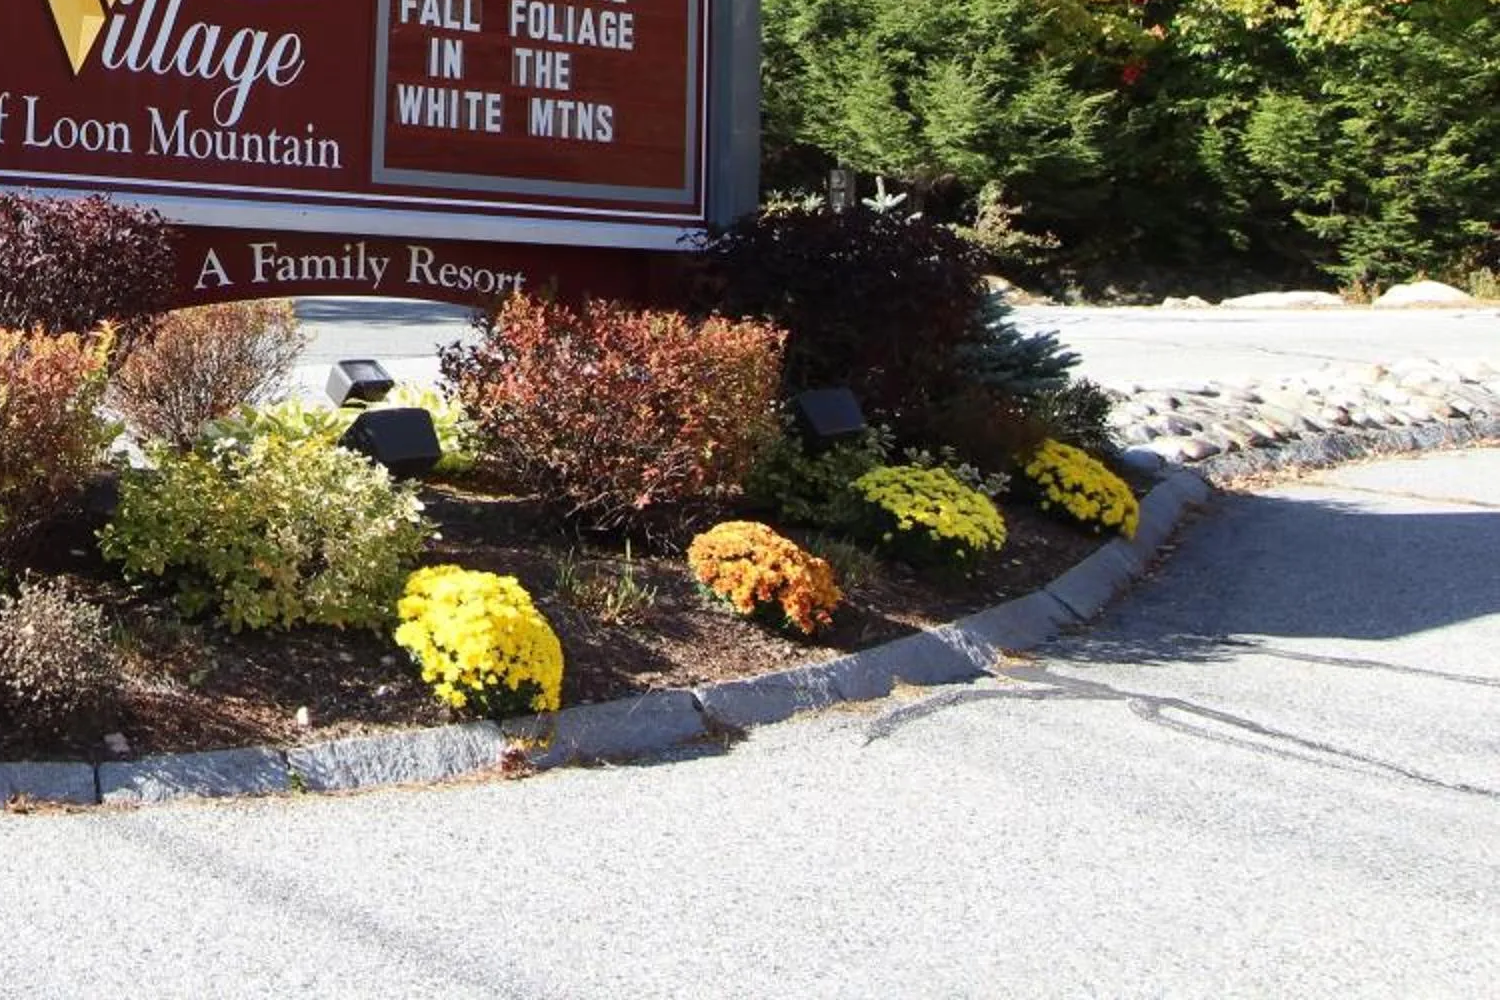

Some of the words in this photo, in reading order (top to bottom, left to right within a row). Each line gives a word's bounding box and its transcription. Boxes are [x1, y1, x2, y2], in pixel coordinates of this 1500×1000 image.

[510, 0, 633, 50] FOLIAGE
[429, 38, 464, 80] IN
[514, 48, 570, 91] THE
[22, 95, 132, 153] Loon
[147, 107, 342, 169] Mountain
[397, 84, 502, 133] WHITE
[530, 98, 614, 143] MTNS
[194, 247, 234, 289] A
[249, 241, 390, 289] Family
[406, 245, 526, 294] Resort
